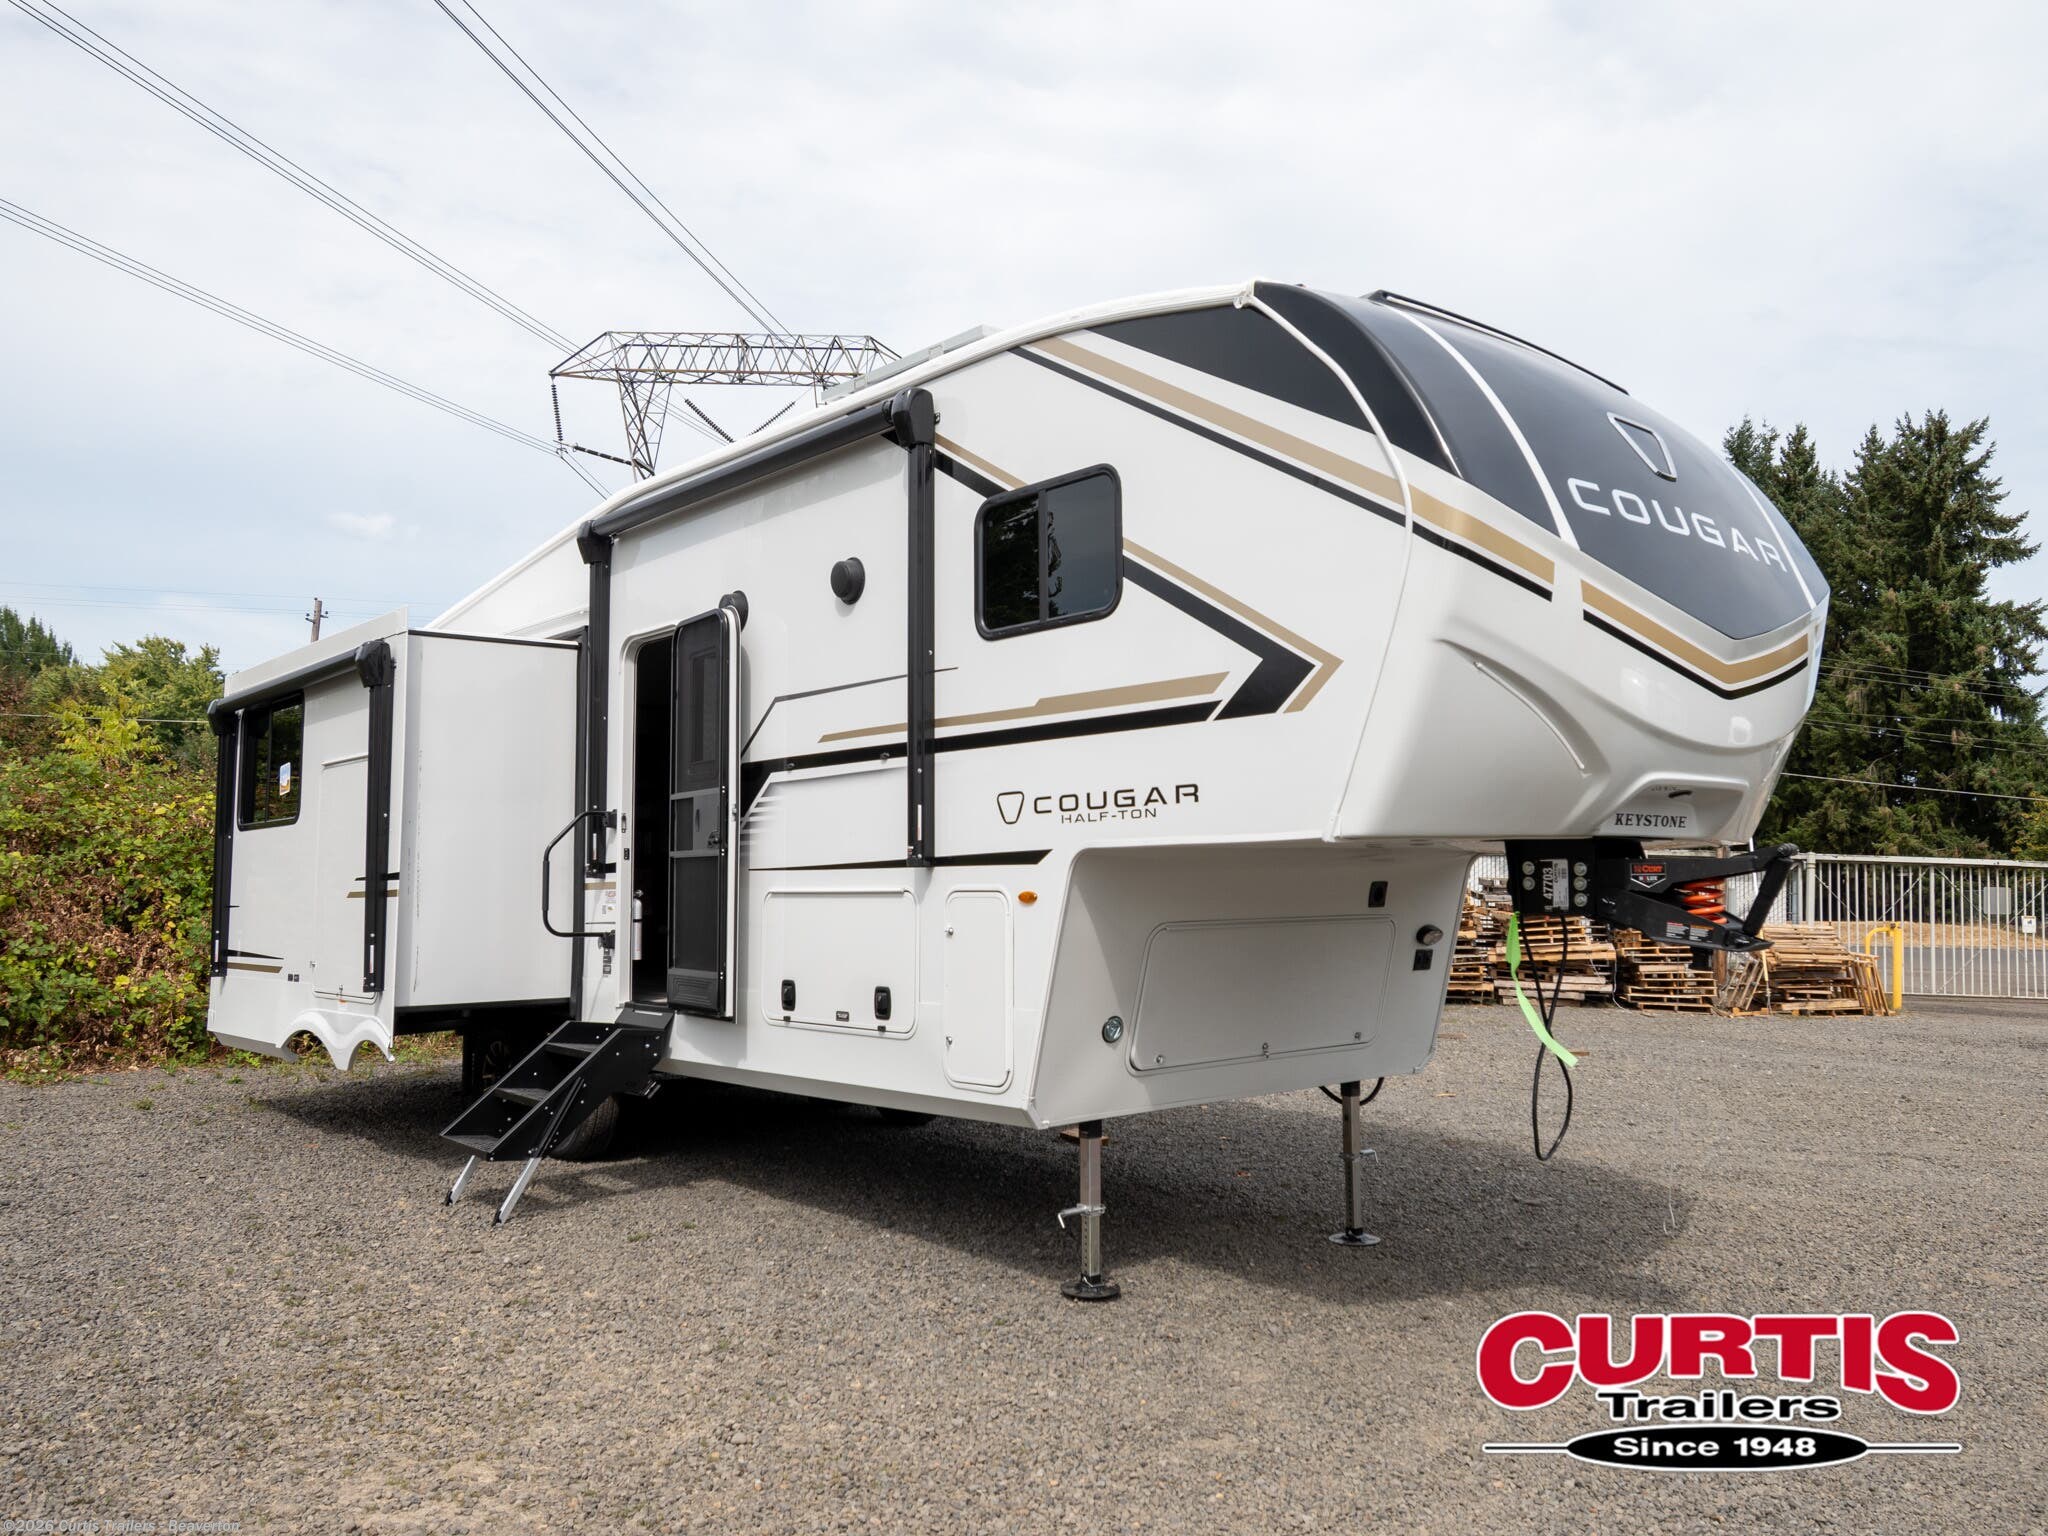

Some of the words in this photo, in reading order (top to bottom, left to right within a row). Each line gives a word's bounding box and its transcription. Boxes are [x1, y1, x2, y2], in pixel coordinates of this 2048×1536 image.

[1567, 477, 1787, 573] COUGAR
[1033, 784, 1199, 814] COUGAR
[1061, 808, 1158, 824] HALF-TON
[1614, 813, 1687, 829] KEYSTONE
[1542, 867, 1554, 900] 47703
